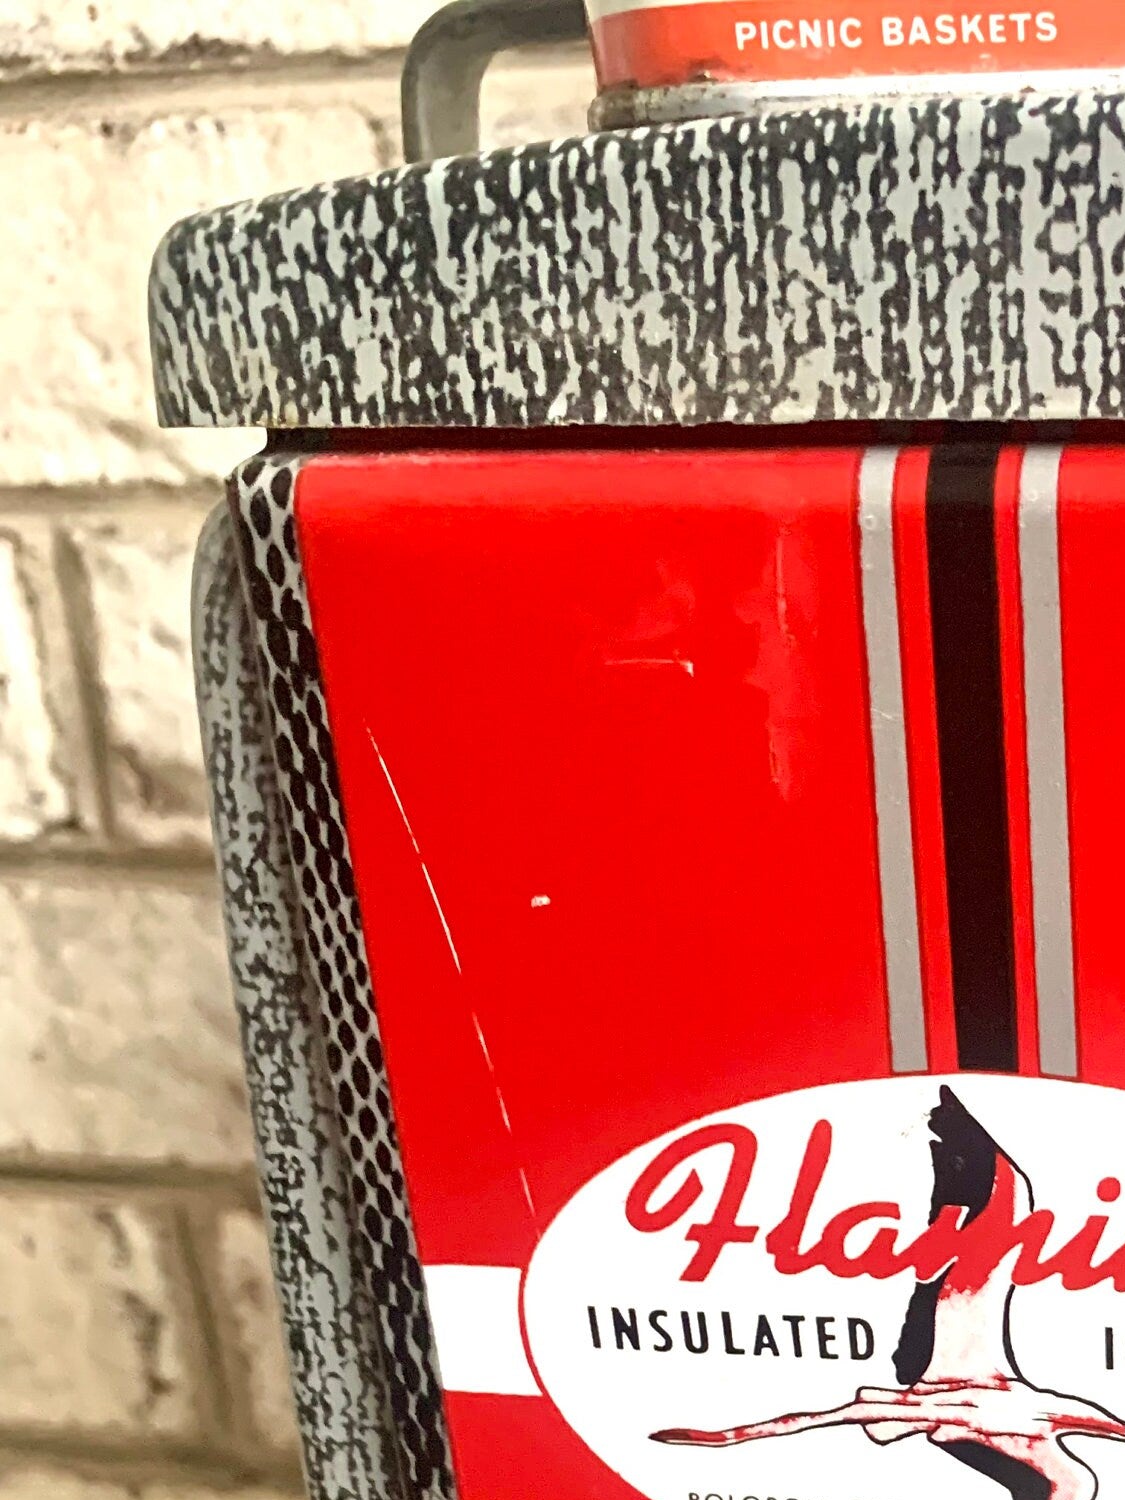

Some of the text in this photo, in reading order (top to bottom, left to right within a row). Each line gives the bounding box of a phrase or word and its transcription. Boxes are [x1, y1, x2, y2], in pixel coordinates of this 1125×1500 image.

[735, 12, 1058, 50] PICNIC BASKETS
[587, 1305, 876, 1362] INSULATED
